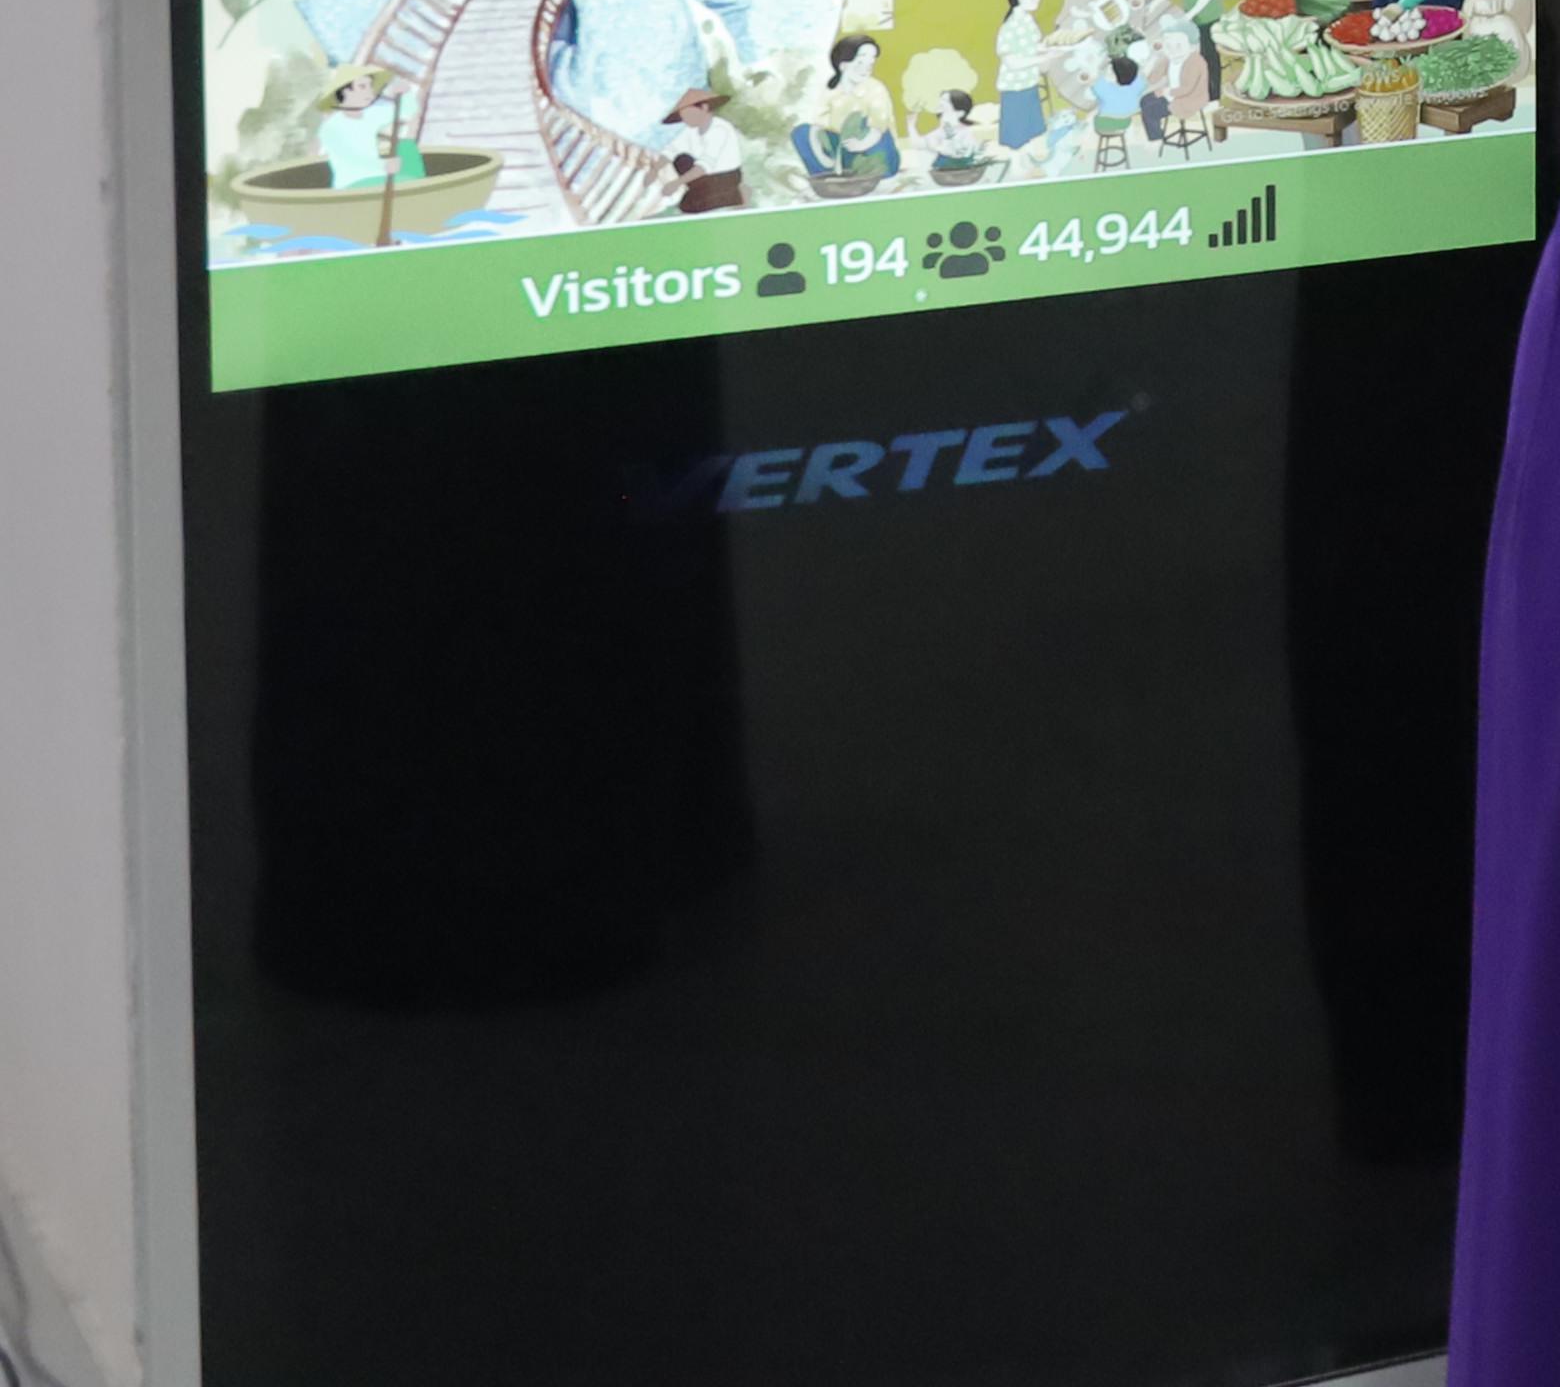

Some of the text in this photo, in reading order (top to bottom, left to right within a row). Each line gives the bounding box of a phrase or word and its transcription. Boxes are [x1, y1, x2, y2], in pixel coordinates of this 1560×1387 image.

[520, 206, 1193, 318] Visitors 194 44,944
